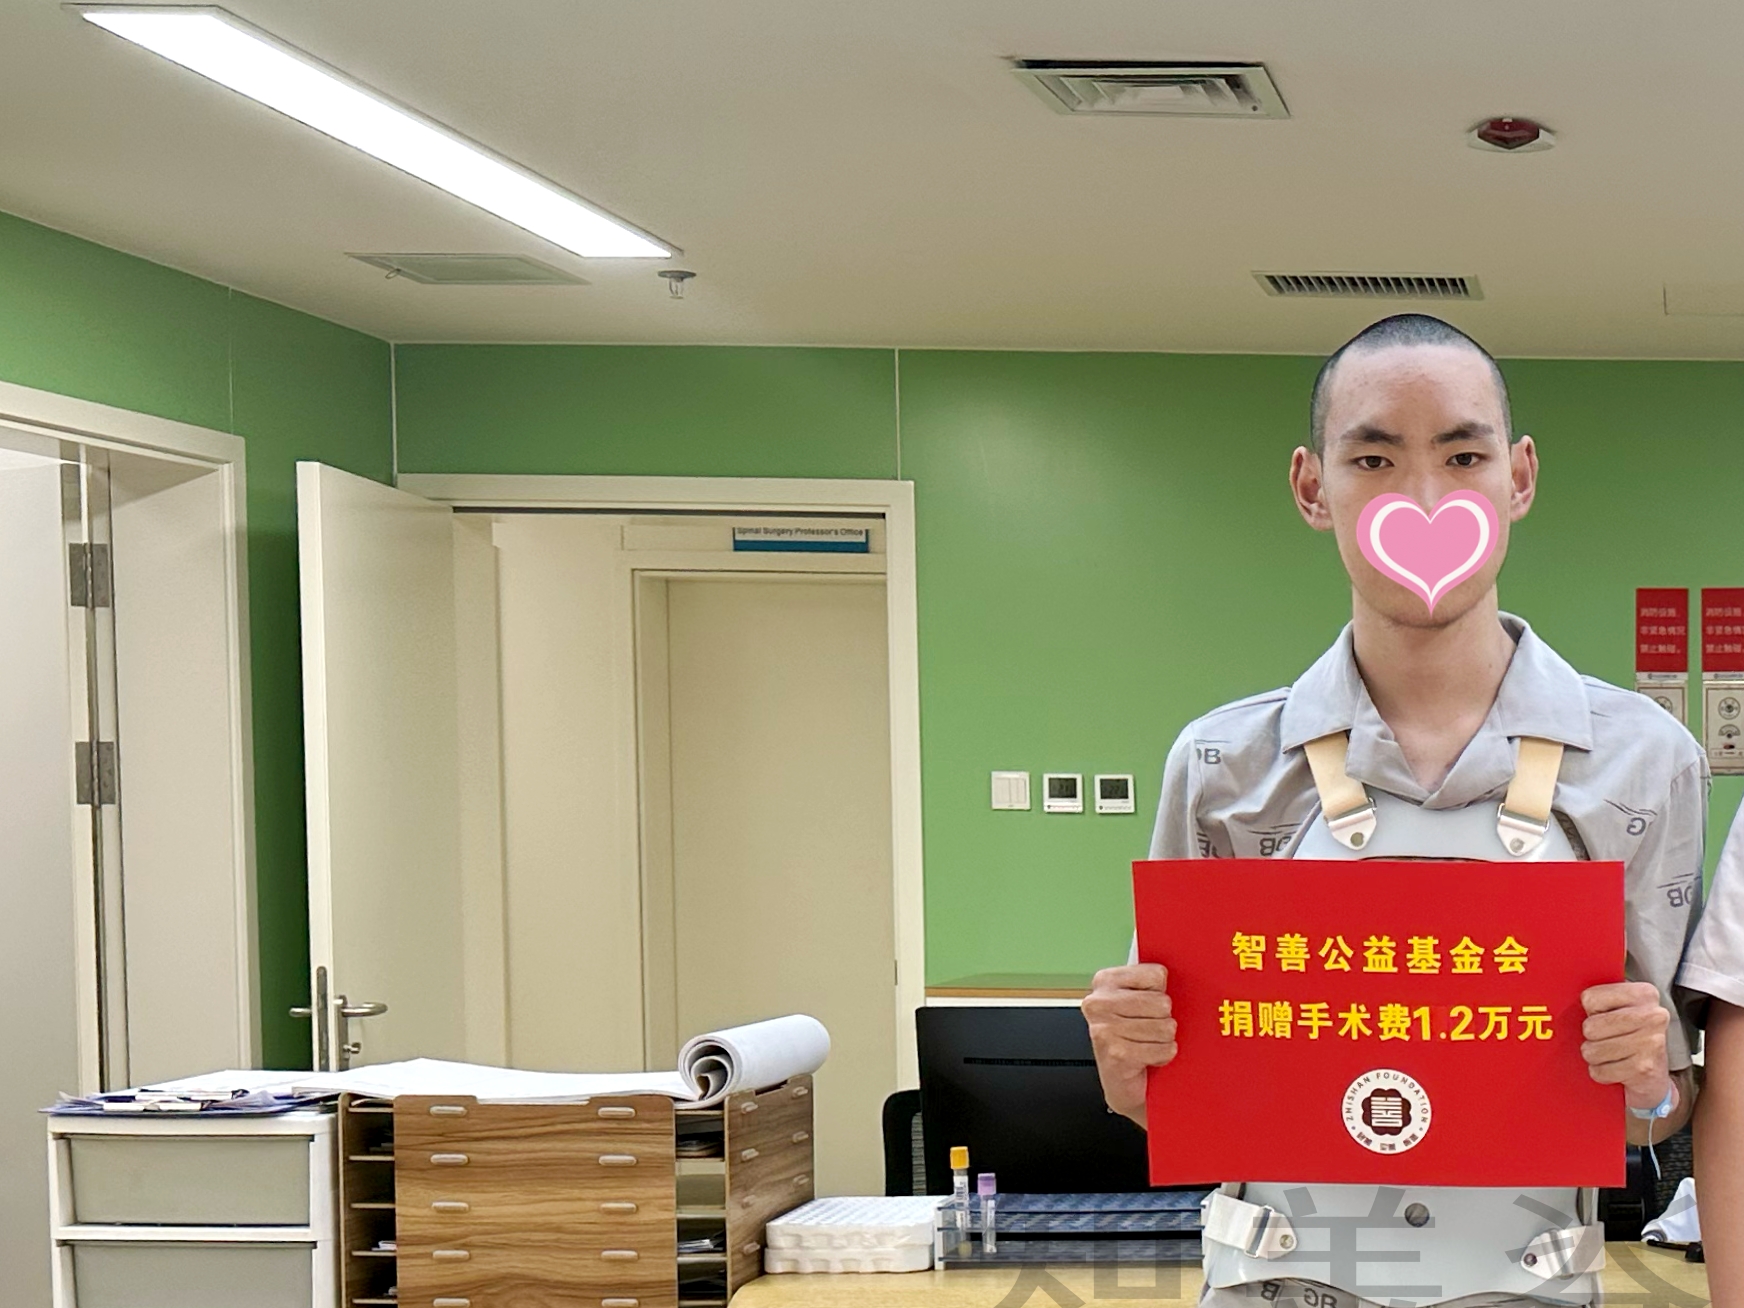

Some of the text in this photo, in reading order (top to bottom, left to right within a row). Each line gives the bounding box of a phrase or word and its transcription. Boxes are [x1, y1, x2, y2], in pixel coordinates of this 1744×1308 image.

[763, 527, 793, 537] Surgery
[795, 527, 838, 536] Professor's
[840, 528, 863, 536] Office
[1232, 931, 1529, 974] 智善公益基金会
[1218, 999, 1554, 1041] 捐赠手术费1.2万元
[1345, 1072, 1429, 1123] ZHISHAN FOUNDATION
